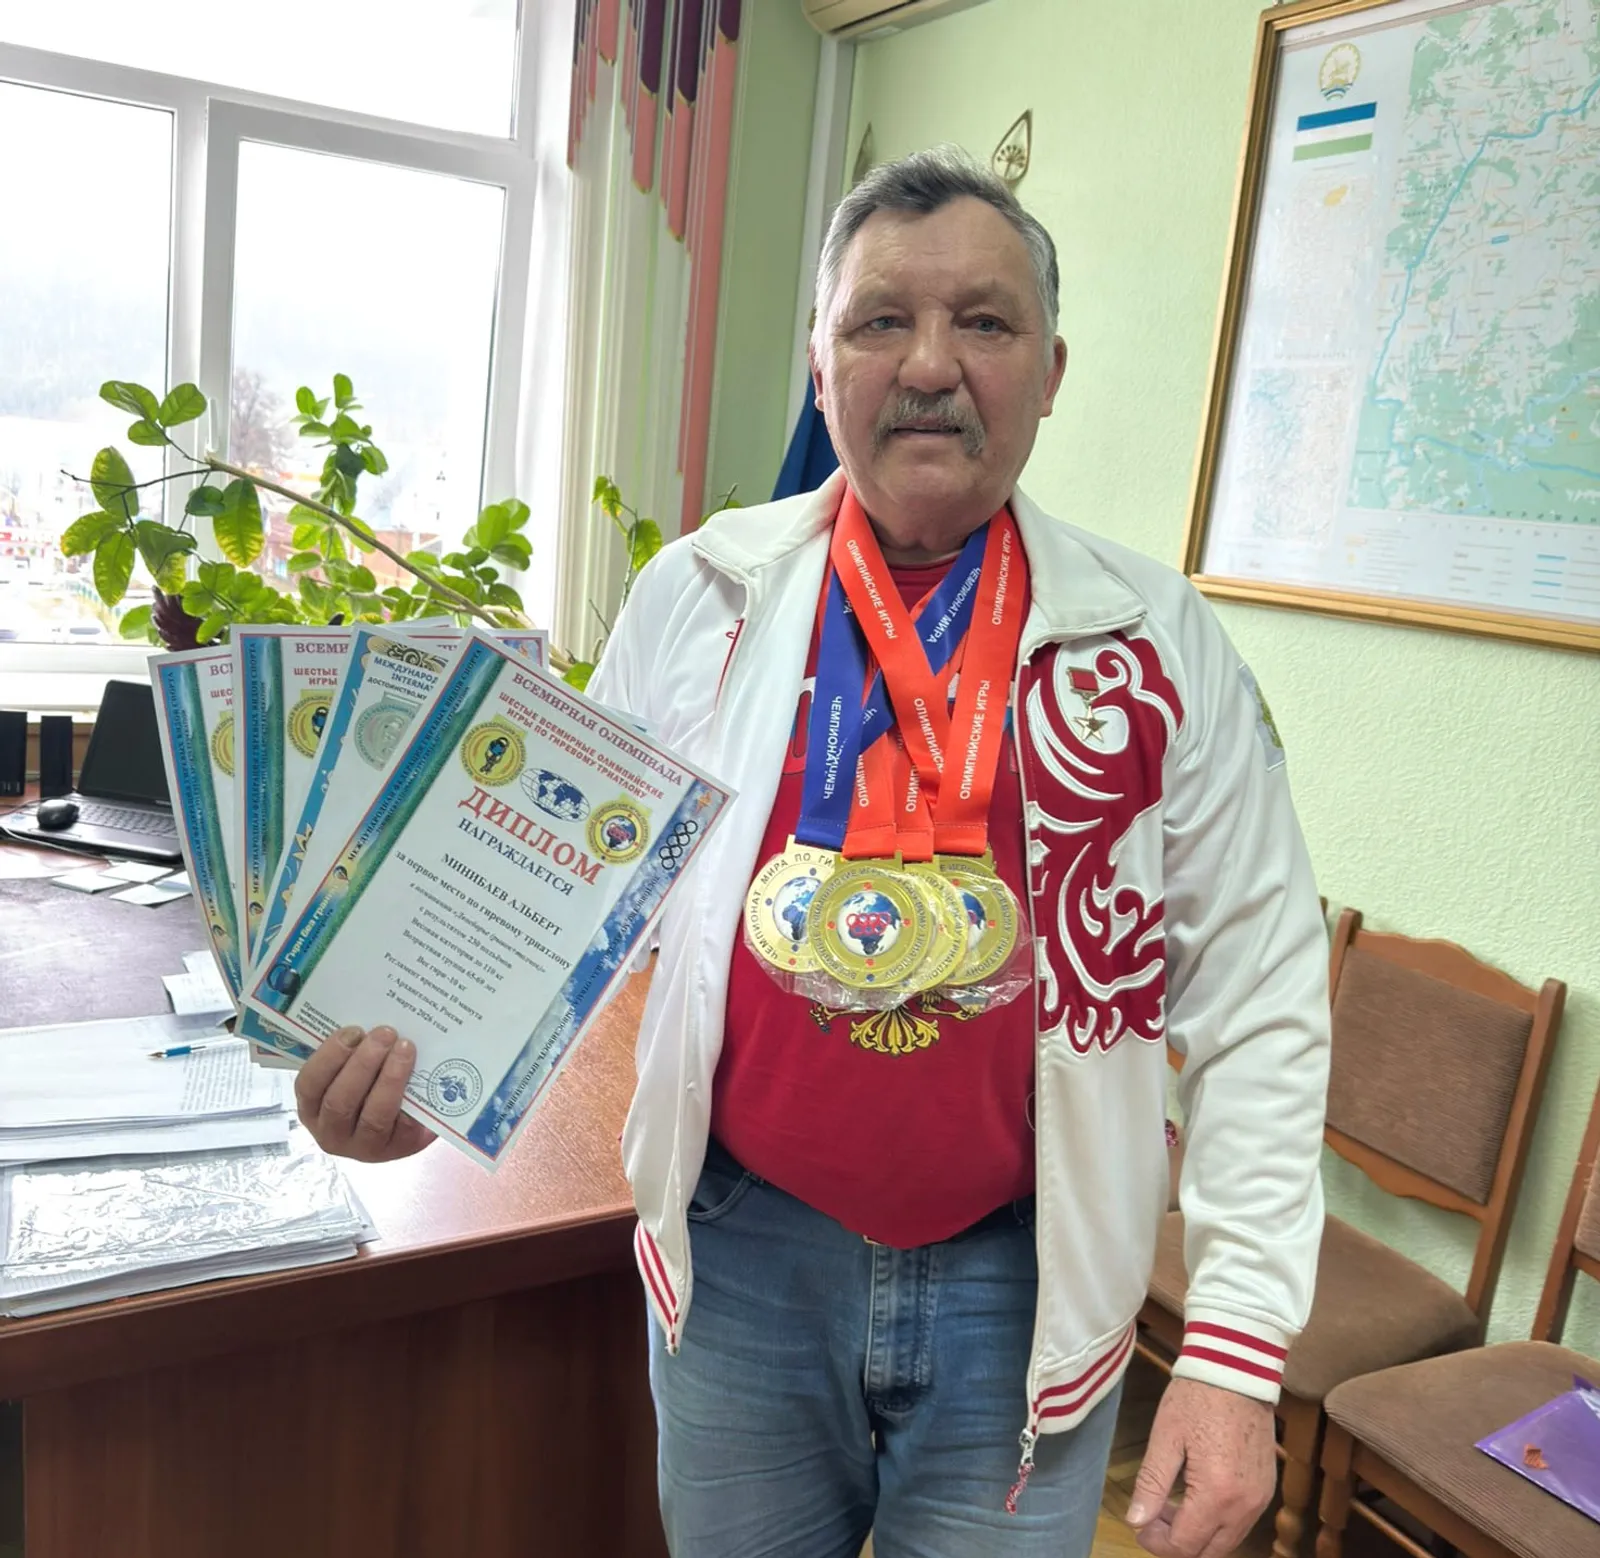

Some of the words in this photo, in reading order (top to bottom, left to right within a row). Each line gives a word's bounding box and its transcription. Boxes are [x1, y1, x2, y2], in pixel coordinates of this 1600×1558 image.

[846, 540, 884, 608] ОЛИМПИЙСКИЕ
[878, 610, 897, 639] ИГРЫ
[926, 615, 952, 643] МИРА
[948, 567, 981, 617] ЧЕМПИОНАТ
[992, 553, 1010, 625] ОЛИМПИЙСКИЕ
[294, 668, 338, 676] ШЕСТЫЕ
[309, 677, 337, 685] ИГРЫ
[498, 691, 538, 721] ШЕСТЫЕ
[538, 716, 596, 757] ВСЕМИРНЫЕ
[596, 751, 665, 800] ОЛИМПИЙСКИЕ
[506, 706, 534, 728] ИГРЫ
[533, 724, 548, 737] ПО
[547, 732, 597, 768] ГИРЕВОМУ
[595, 762, 647, 800] ТРИАТЛОНУ
[511, 671, 597, 732] ВСЕМИРНАЯ
[596, 724, 685, 788] ОЛИМПИАДА
[960, 713, 985, 800] ОЛИМПИЙСКИЕ
[976, 680, 990, 710] ИГРЫ
[456, 815, 575, 899] НАГРАЖДАЕТСЯ
[457, 785, 606, 887] ДИПЛОМ
[761, 859, 788, 885] МИРА
[795, 853, 811, 862] ПО
[395, 850, 406, 861] за
[405, 858, 439, 884] первое
[438, 879, 466, 900] место
[466, 896, 479, 909] по
[477, 905, 523, 938] гиревому
[521, 933, 572, 971] триатлону
[440, 852, 509, 902] МИНИБАЕВ
[506, 895, 563, 937] АЛЬБЕРТ
[751, 890, 779, 960] ЧЕМПИОНАТ
